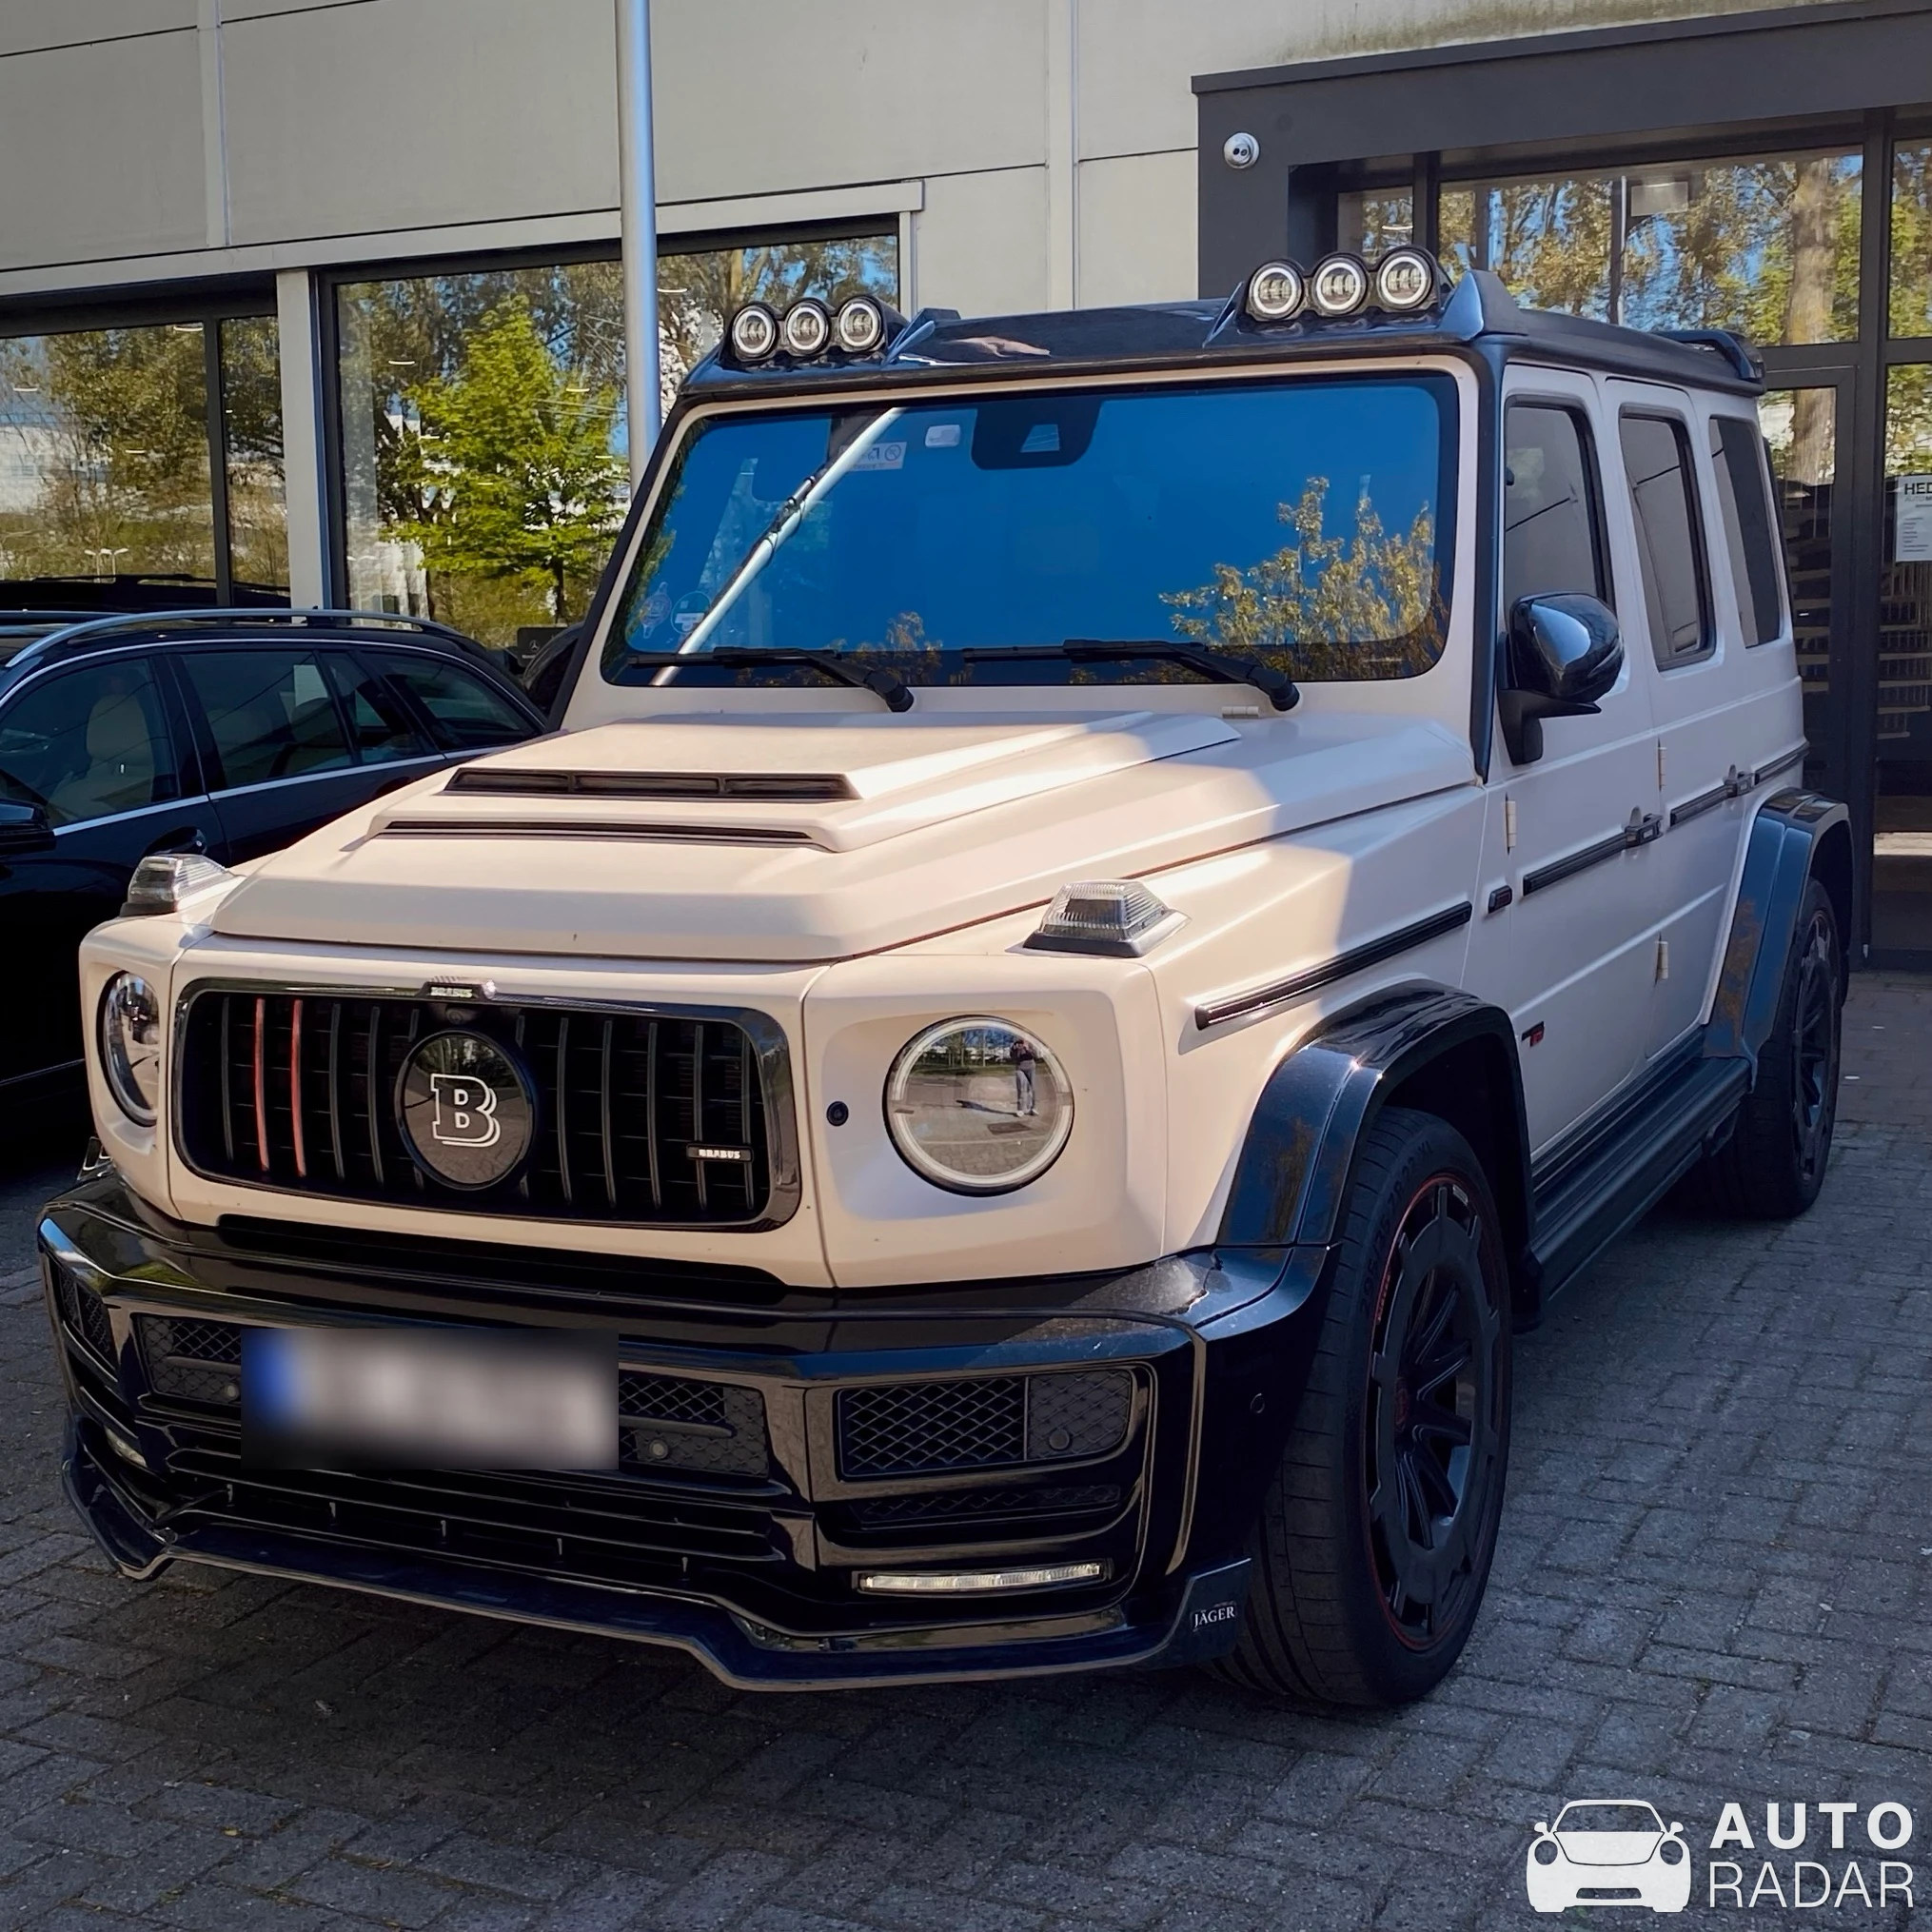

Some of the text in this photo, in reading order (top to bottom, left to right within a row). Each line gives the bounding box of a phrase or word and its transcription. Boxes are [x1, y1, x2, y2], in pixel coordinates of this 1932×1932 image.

[431, 1074, 501, 1147] B
[699, 1149, 740, 1159] BRABUS
[1194, 1606, 1235, 1628] JÄGER
